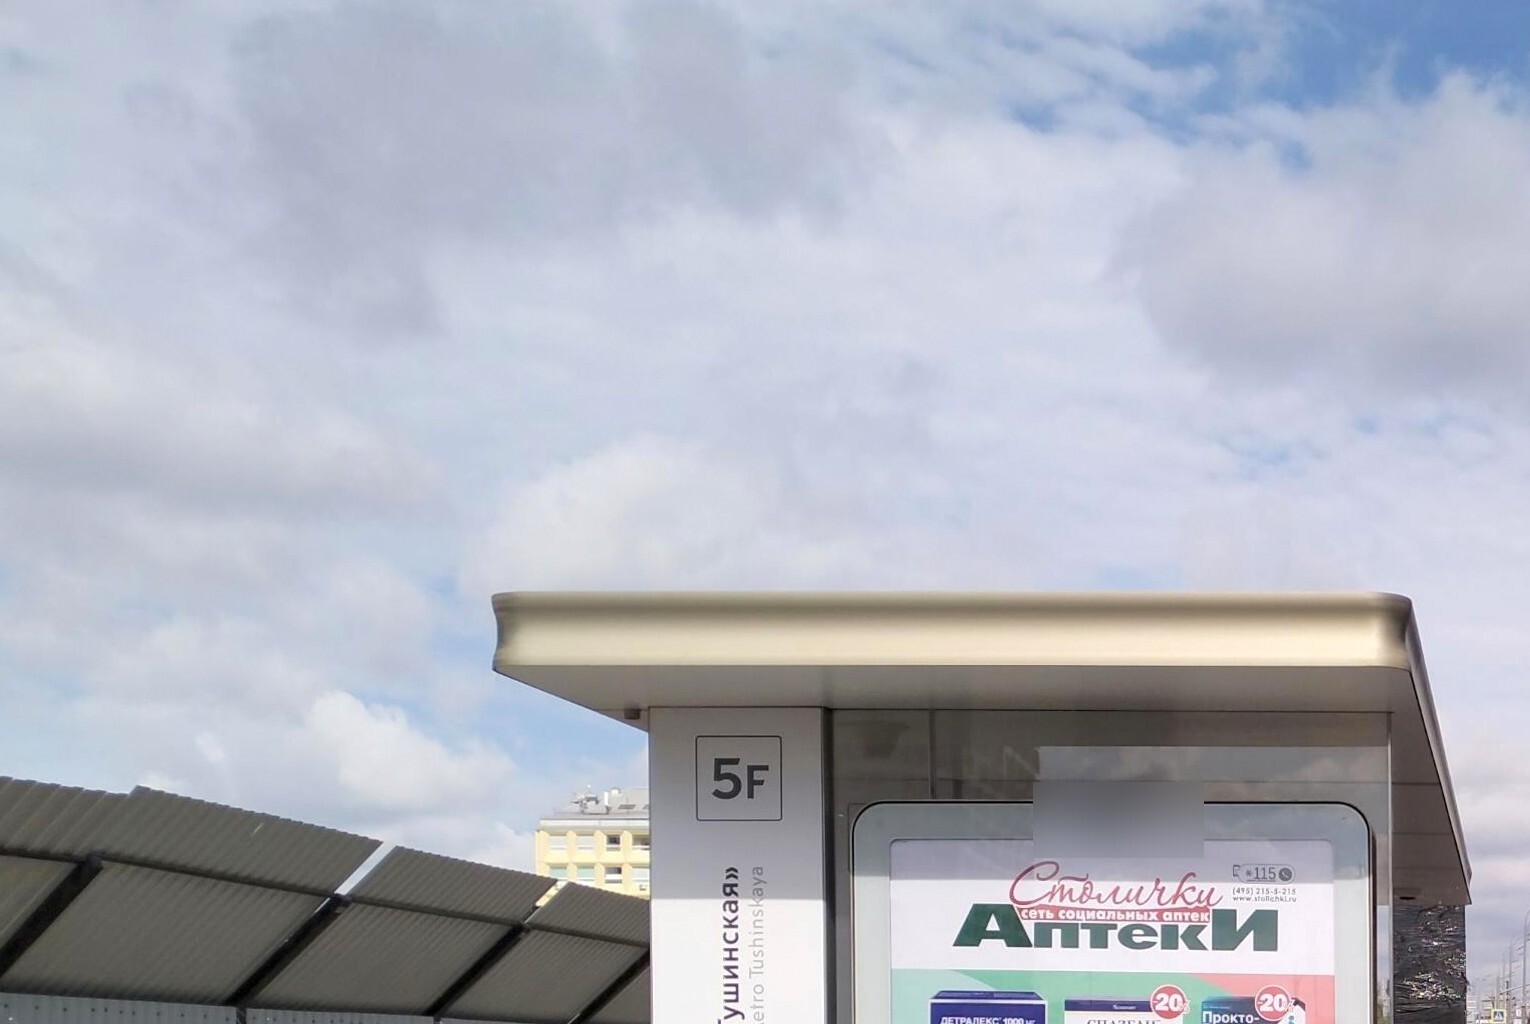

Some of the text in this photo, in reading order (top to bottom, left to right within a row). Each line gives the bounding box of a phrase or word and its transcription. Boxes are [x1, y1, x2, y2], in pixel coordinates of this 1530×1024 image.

[712, 758, 769, 799] 5F
[1009, 861, 1224, 907] Столички
[749, 866, 767, 979] Tushinskaya
[1021, 909, 1210, 923] сеть социальных аптек
[1202, 1011, 1260, 1024] Прокто-
